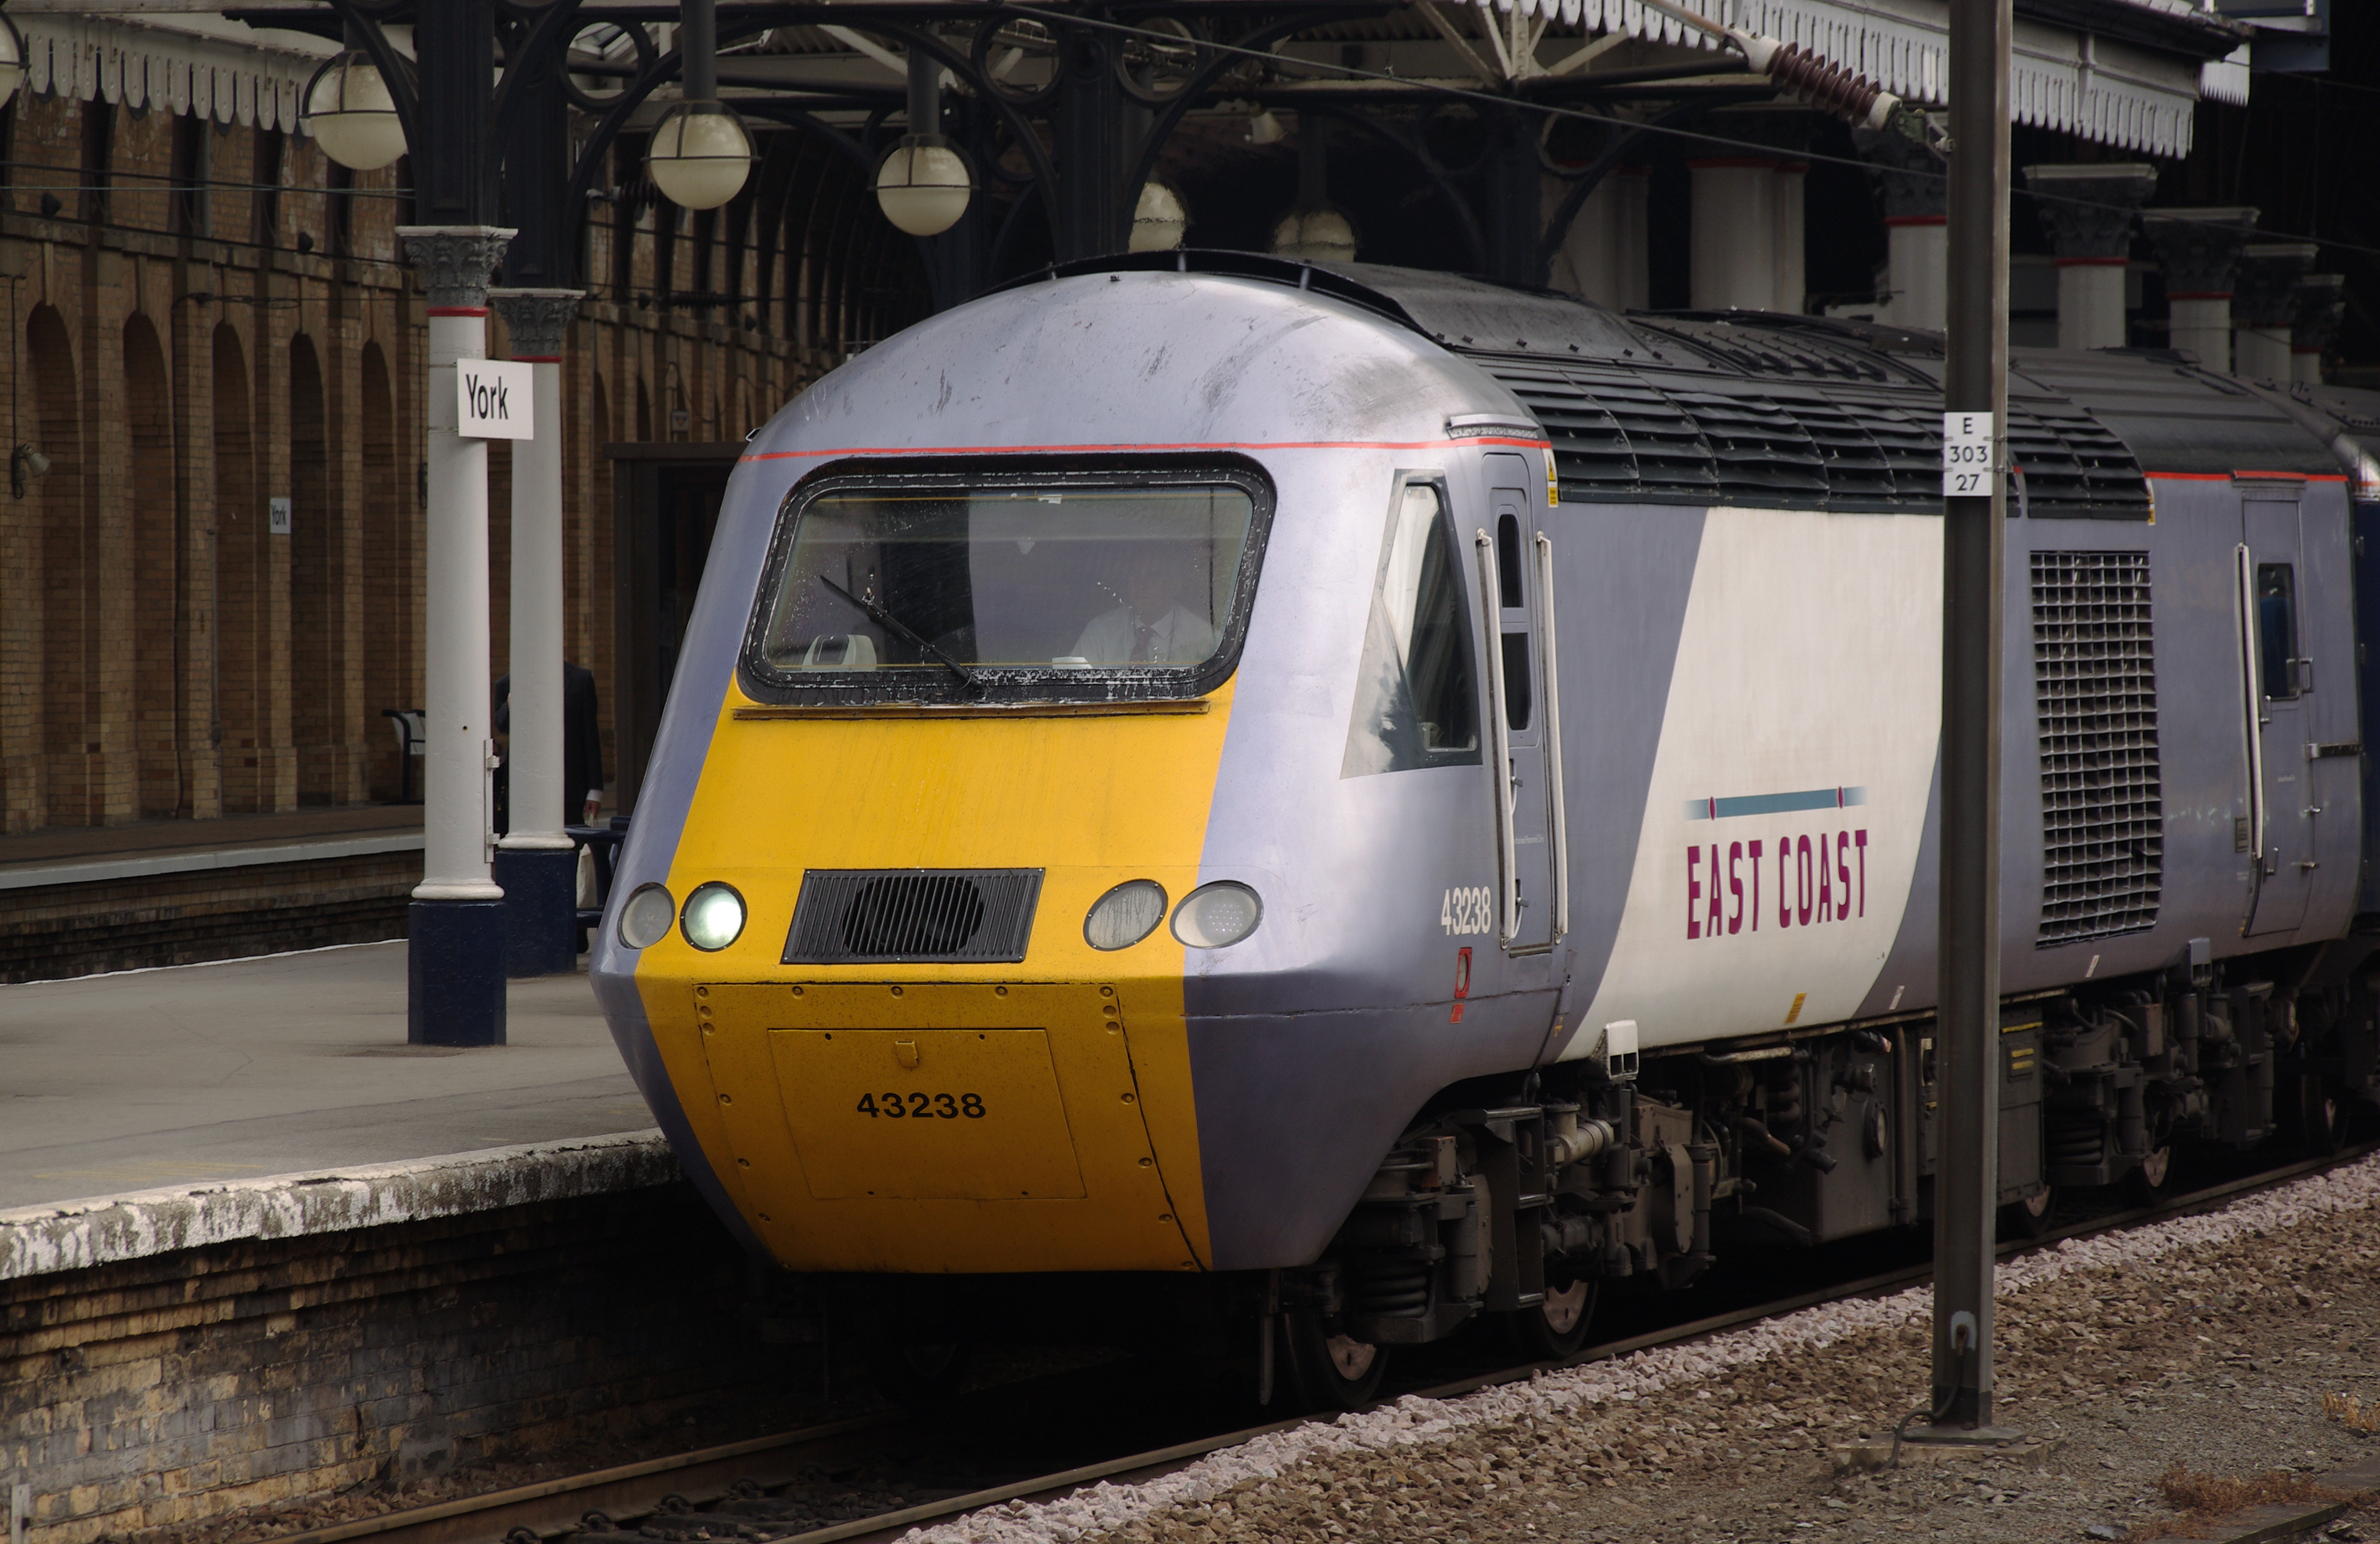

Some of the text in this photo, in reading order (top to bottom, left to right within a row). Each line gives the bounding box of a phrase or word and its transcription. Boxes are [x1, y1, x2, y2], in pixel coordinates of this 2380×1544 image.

[466, 374, 508, 419] York
[1964, 418, 1972, 434] E
[1949, 446, 1987, 462] 303
[1956, 474, 1980, 491] 27
[270, 505, 286, 525] York
[1687, 830, 1867, 939] EAST COAST
[1441, 885, 1491, 935] 43238
[857, 1093, 986, 1118] 43238
